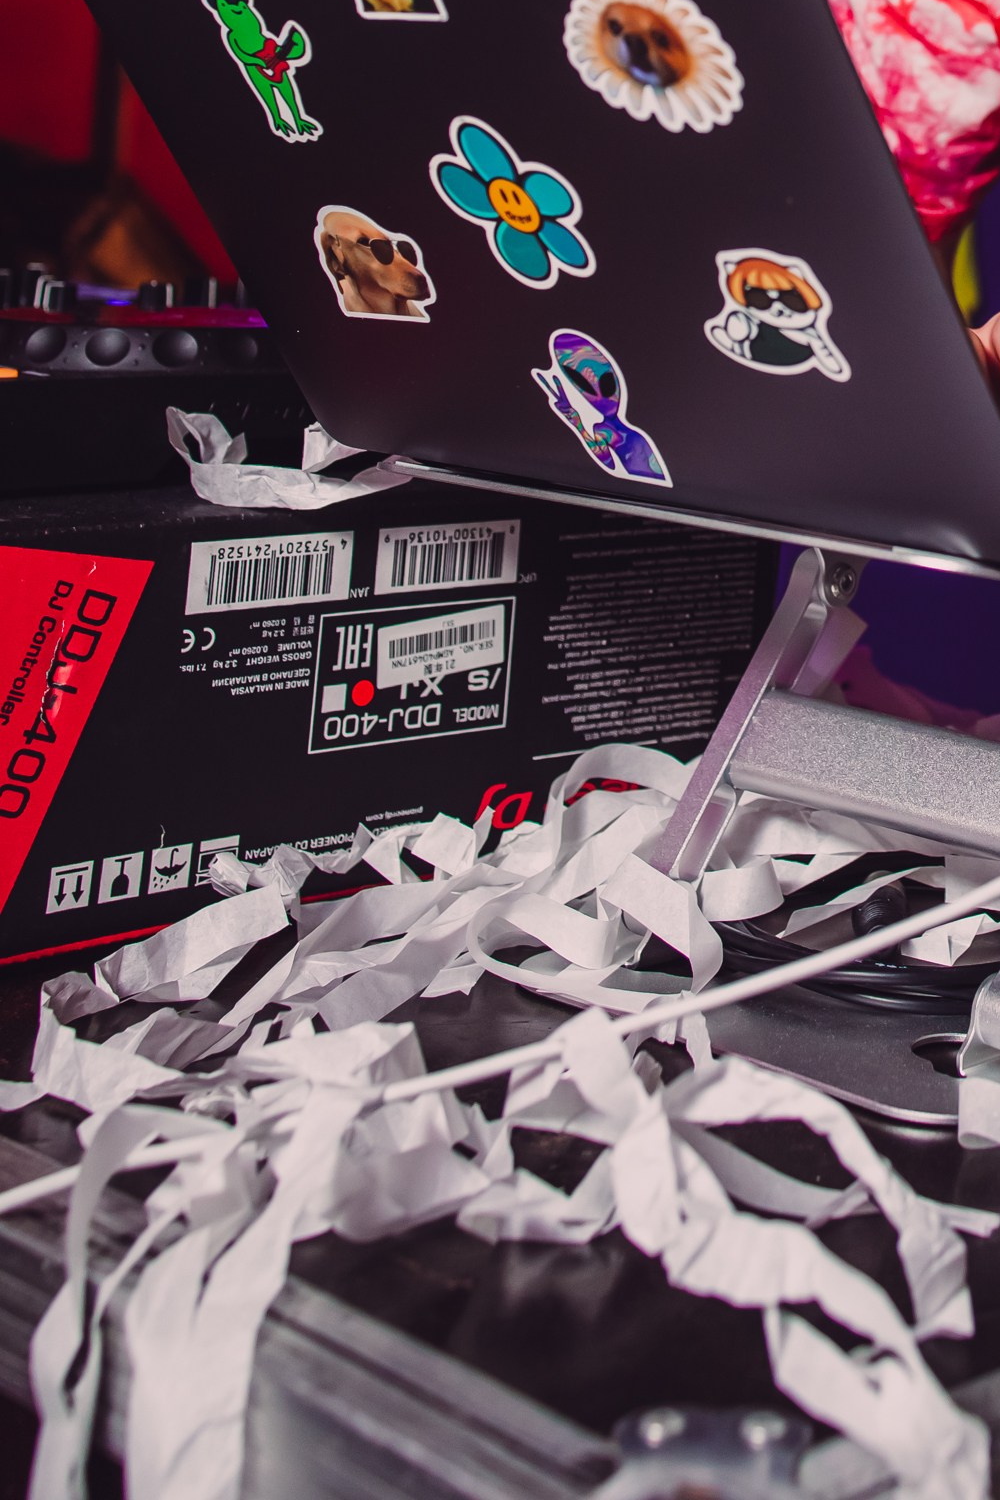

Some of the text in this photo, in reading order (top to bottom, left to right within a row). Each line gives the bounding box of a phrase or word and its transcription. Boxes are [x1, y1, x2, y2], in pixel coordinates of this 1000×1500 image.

[384, 533, 391, 543] 9
[408, 530, 447, 543] 10136
[453, 527, 492, 541] 41300
[217, 538, 347, 560] 4 573201 241528
[48, 580, 74, 611] DJ
[350, 586, 370, 598] JAN
[242, 645, 268, 655] 0.0260
[278, 640, 312, 651] VOLUME
[245, 654, 280, 666] WEIGHT
[282, 651, 312, 662] GROSS
[213, 660, 223, 669] kg
[225, 659, 238, 668] 3.2
[230, 679, 310, 696] MADE IN MALAYSIA
[323, 702, 499, 740] MODEL DDJ-400
[295, 840, 309, 850] DJ
[310, 832, 355, 849] PIONEER
